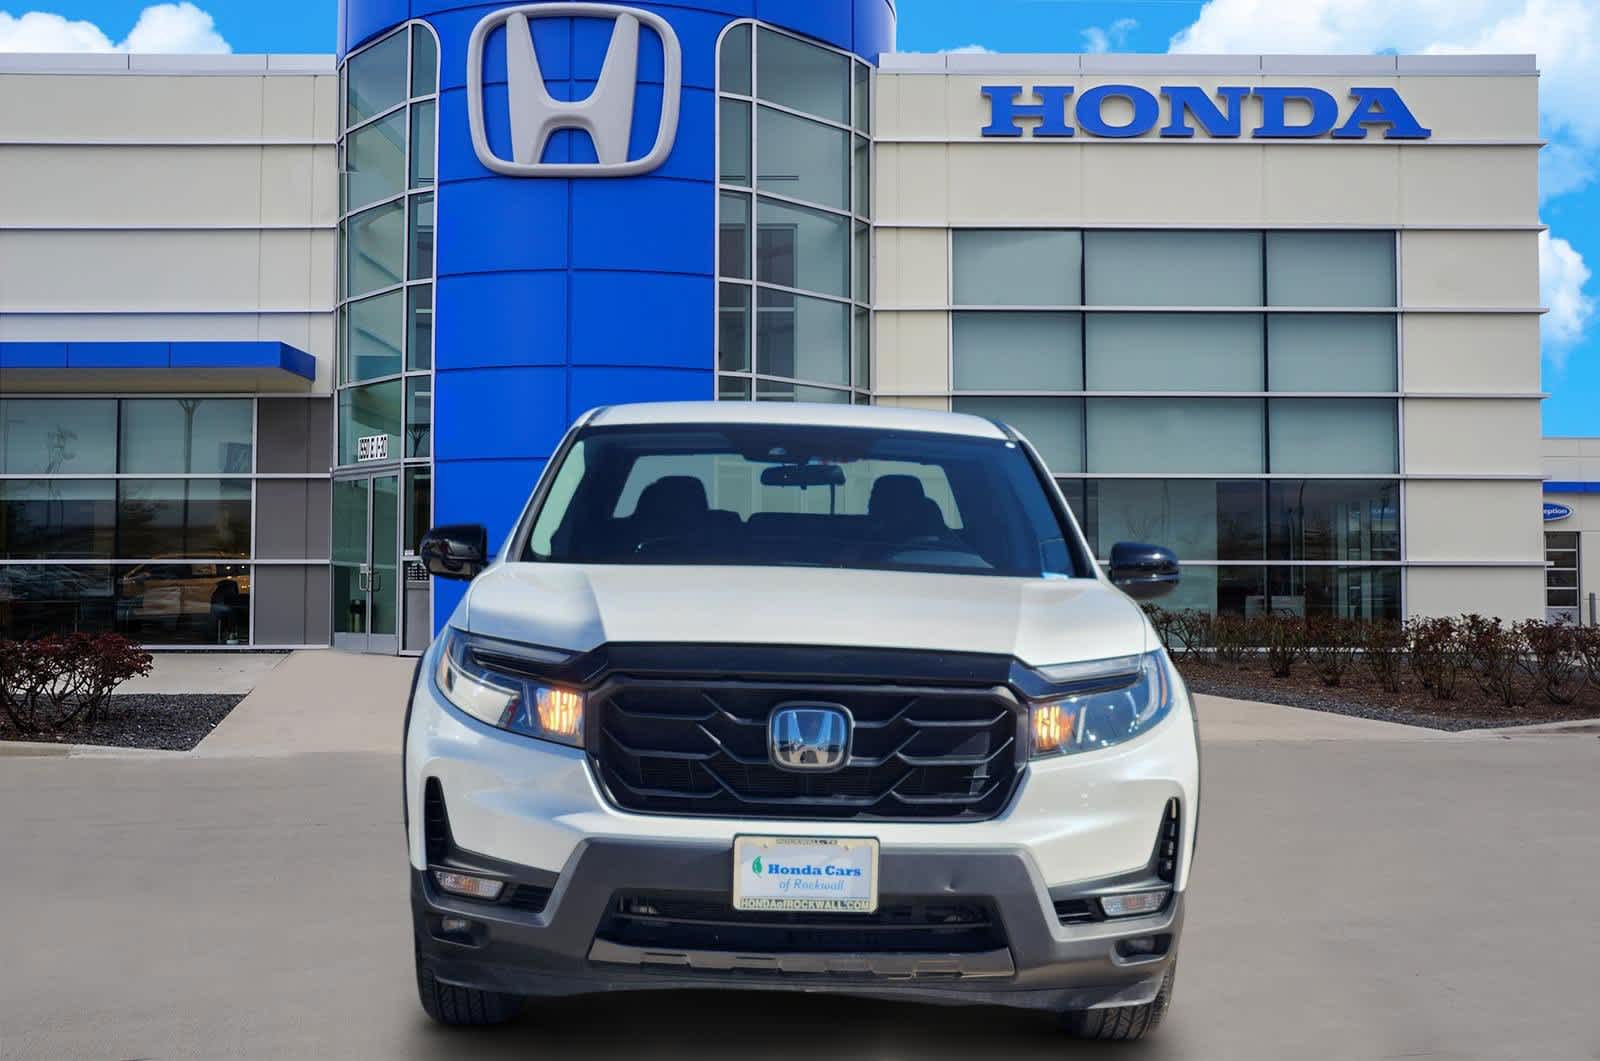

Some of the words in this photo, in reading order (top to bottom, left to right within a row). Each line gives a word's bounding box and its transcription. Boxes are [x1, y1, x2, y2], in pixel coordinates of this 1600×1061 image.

[981, 85, 1432, 139] HONDA
[768, 864, 822, 875] Honda
[825, 865, 862, 876] Cars
[779, 879, 791, 892] of
[793, 879, 845, 891] Rockwall
